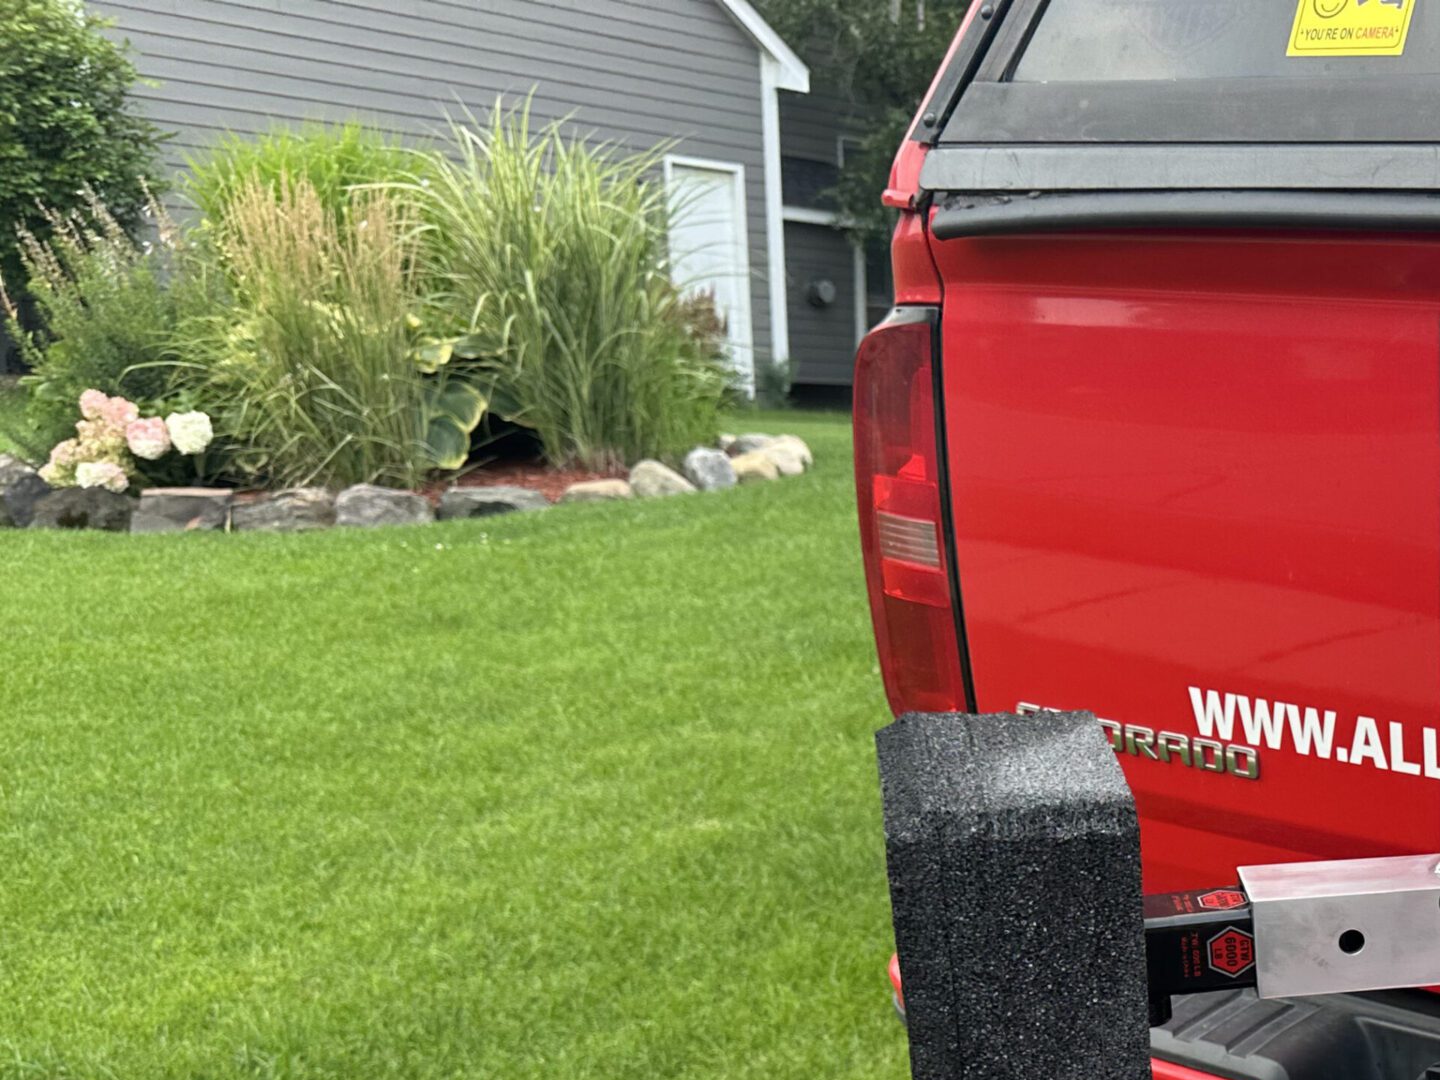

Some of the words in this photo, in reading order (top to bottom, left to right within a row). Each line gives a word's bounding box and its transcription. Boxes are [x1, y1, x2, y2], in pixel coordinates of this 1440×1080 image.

[1340, 27, 1354, 40] ON
[1355, 26, 1395, 40] CAMERA
[1225, 937, 1238, 966] 6000
